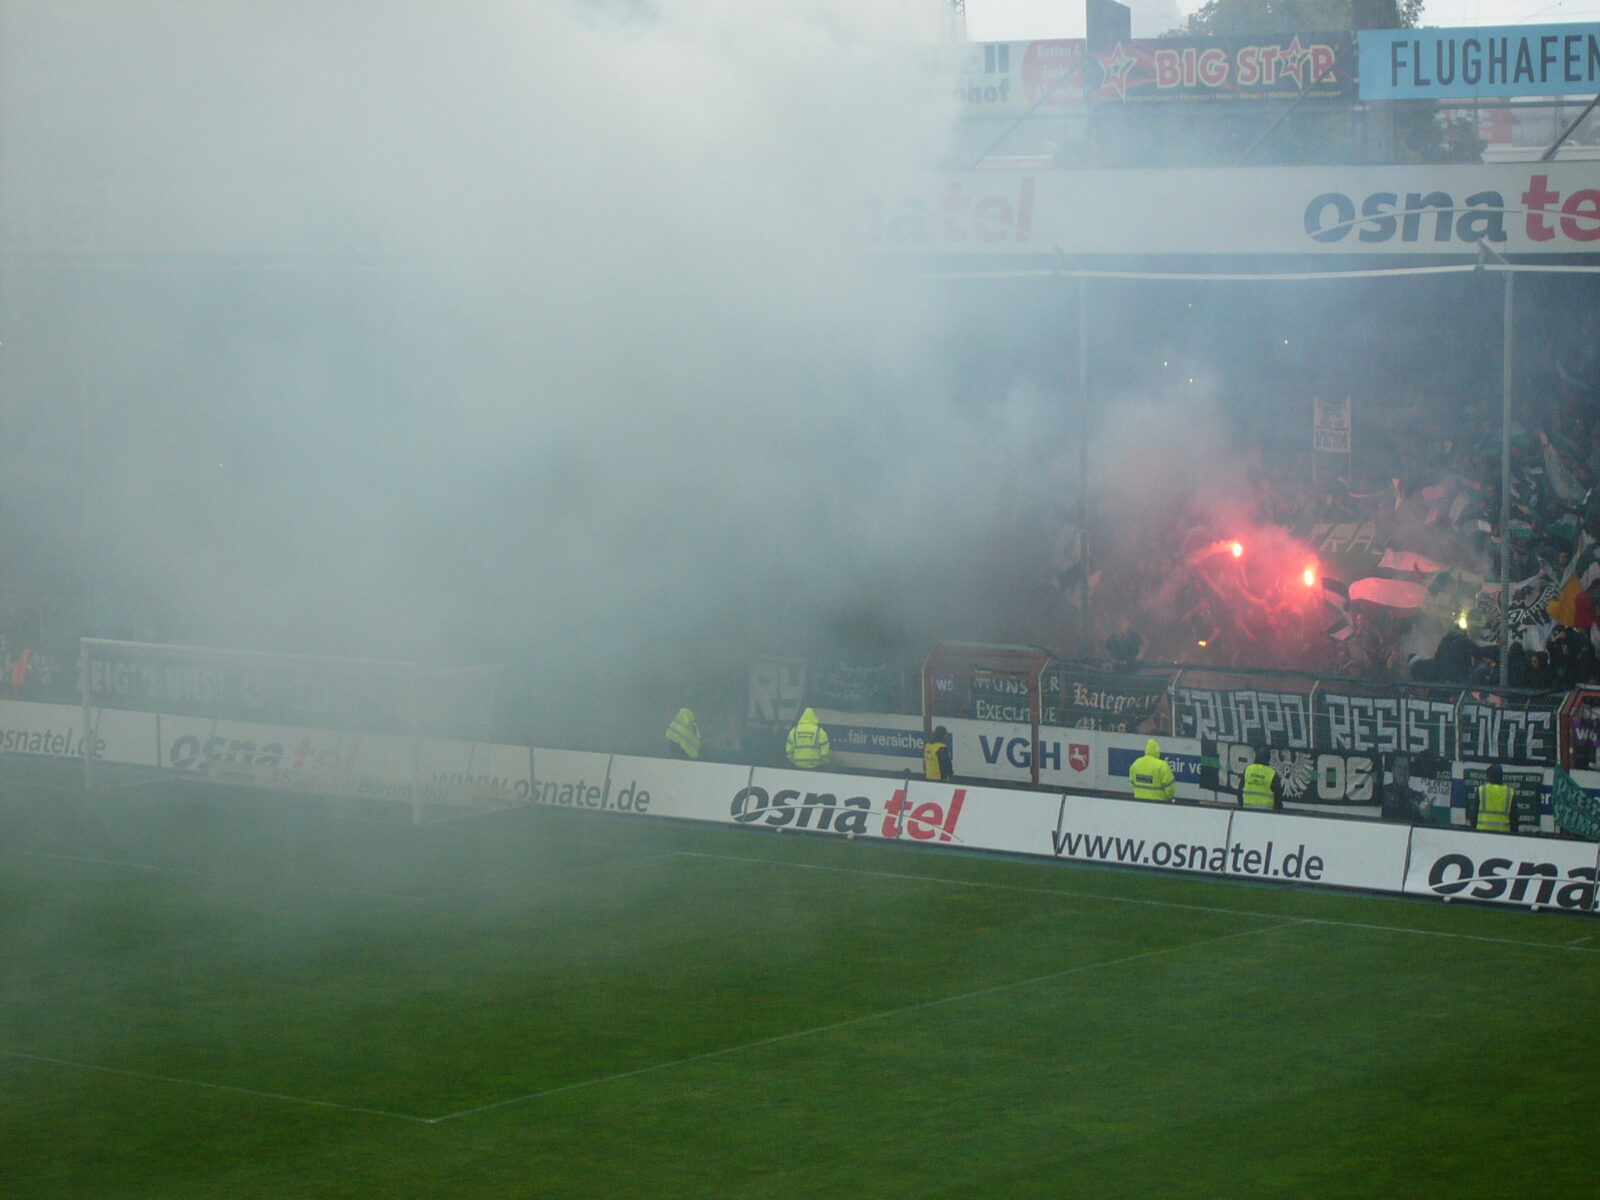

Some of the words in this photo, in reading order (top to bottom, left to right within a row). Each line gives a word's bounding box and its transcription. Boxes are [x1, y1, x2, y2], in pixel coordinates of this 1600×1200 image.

[1154, 47, 1229, 90] BIG
[1392, 34, 1600, 87] FLUGHAFEN
[1324, 693, 1550, 761] RESISTENTE
[979, 735, 1061, 771] VGH
[1317, 753, 1374, 801] 06
[1052, 829, 1324, 881] www.osnatel.de
